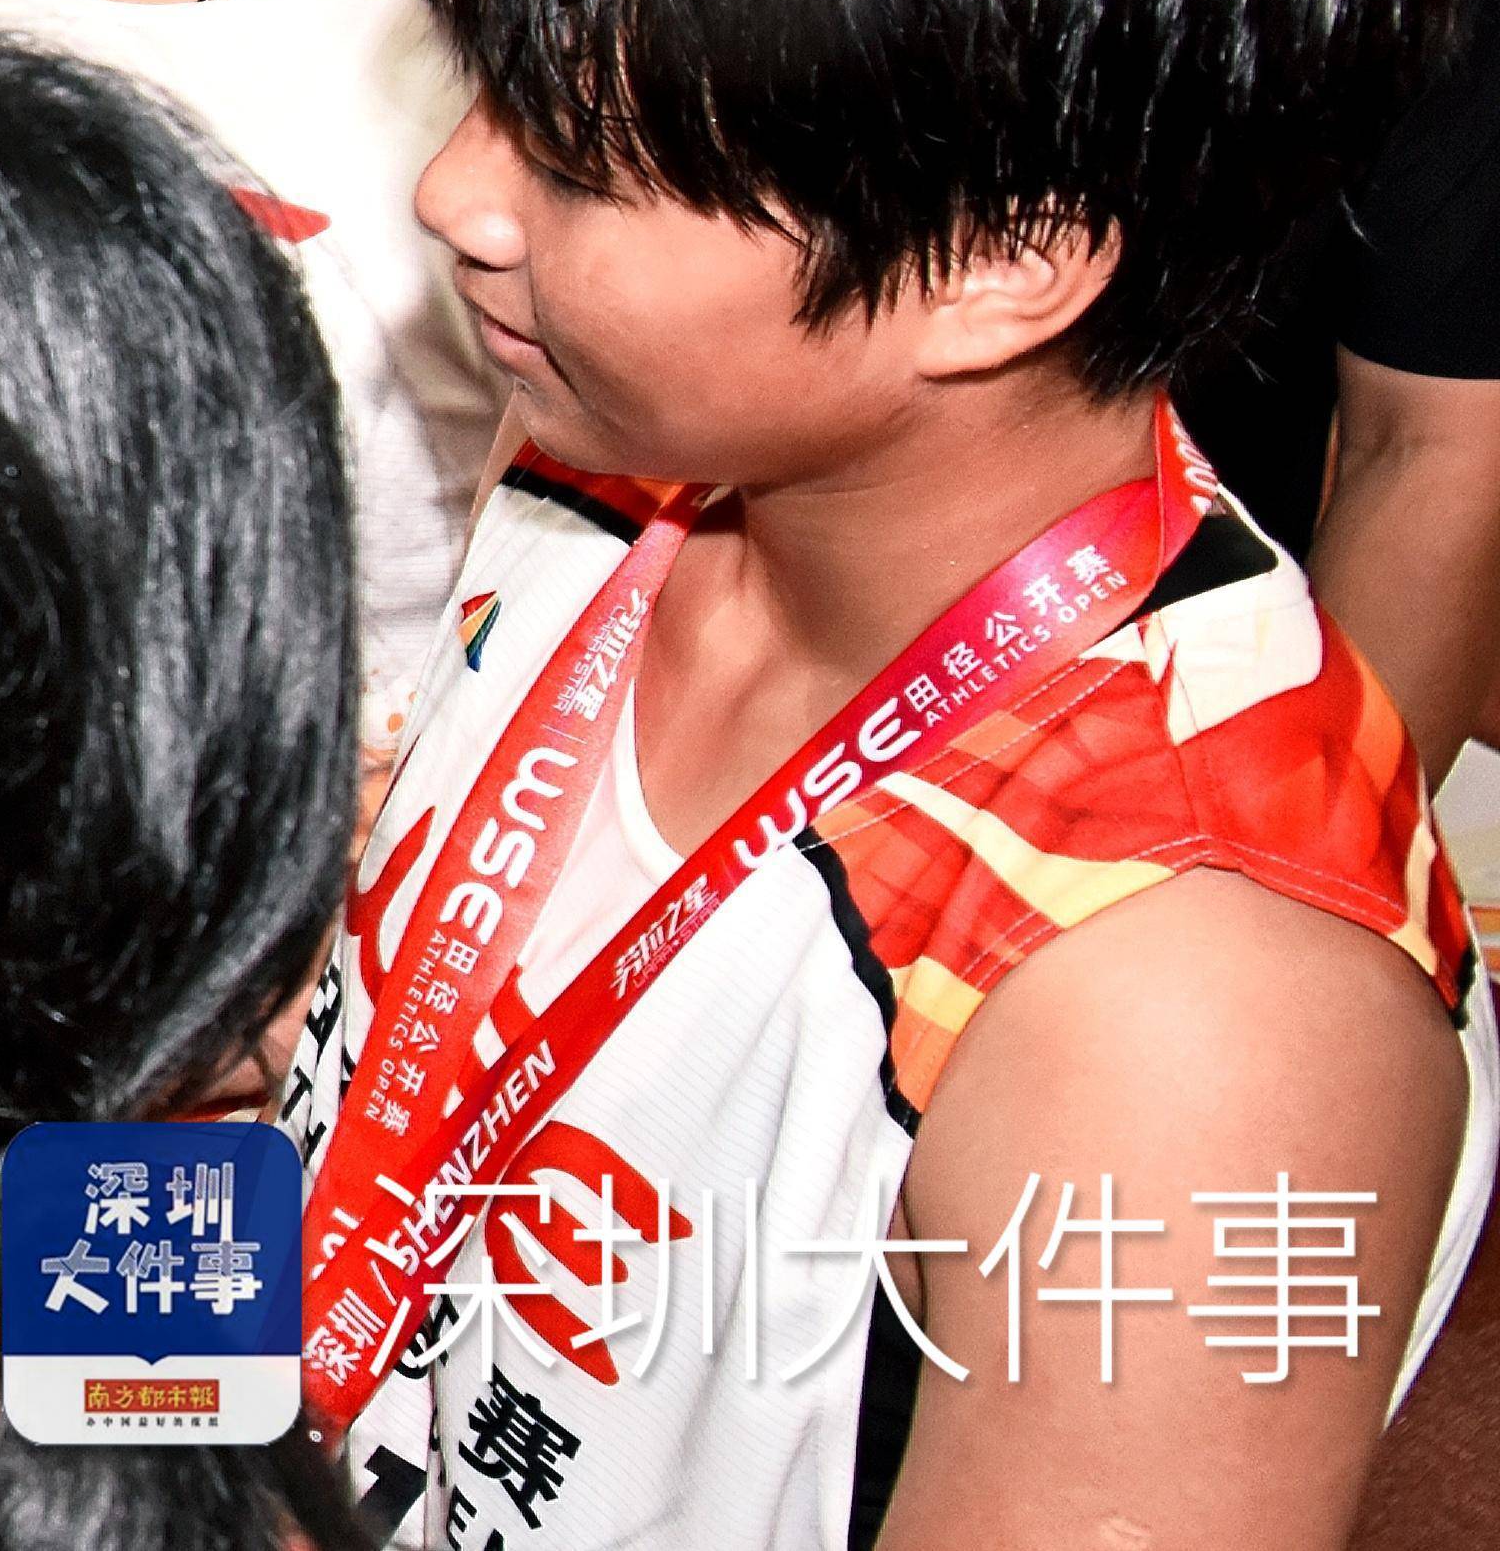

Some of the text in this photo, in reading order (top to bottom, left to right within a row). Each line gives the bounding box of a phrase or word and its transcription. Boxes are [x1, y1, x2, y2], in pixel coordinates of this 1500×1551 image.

[924, 570, 1129, 728] ATHLETICS OPEN
[439, 746, 579, 945] WSE
[612, 543, 1111, 1002] 劳拉之星 WSE 田径公开赛
[365, 929, 444, 1122] ATHLETICS OPEN
[383, 937, 477, 1138] 田径公开赛
